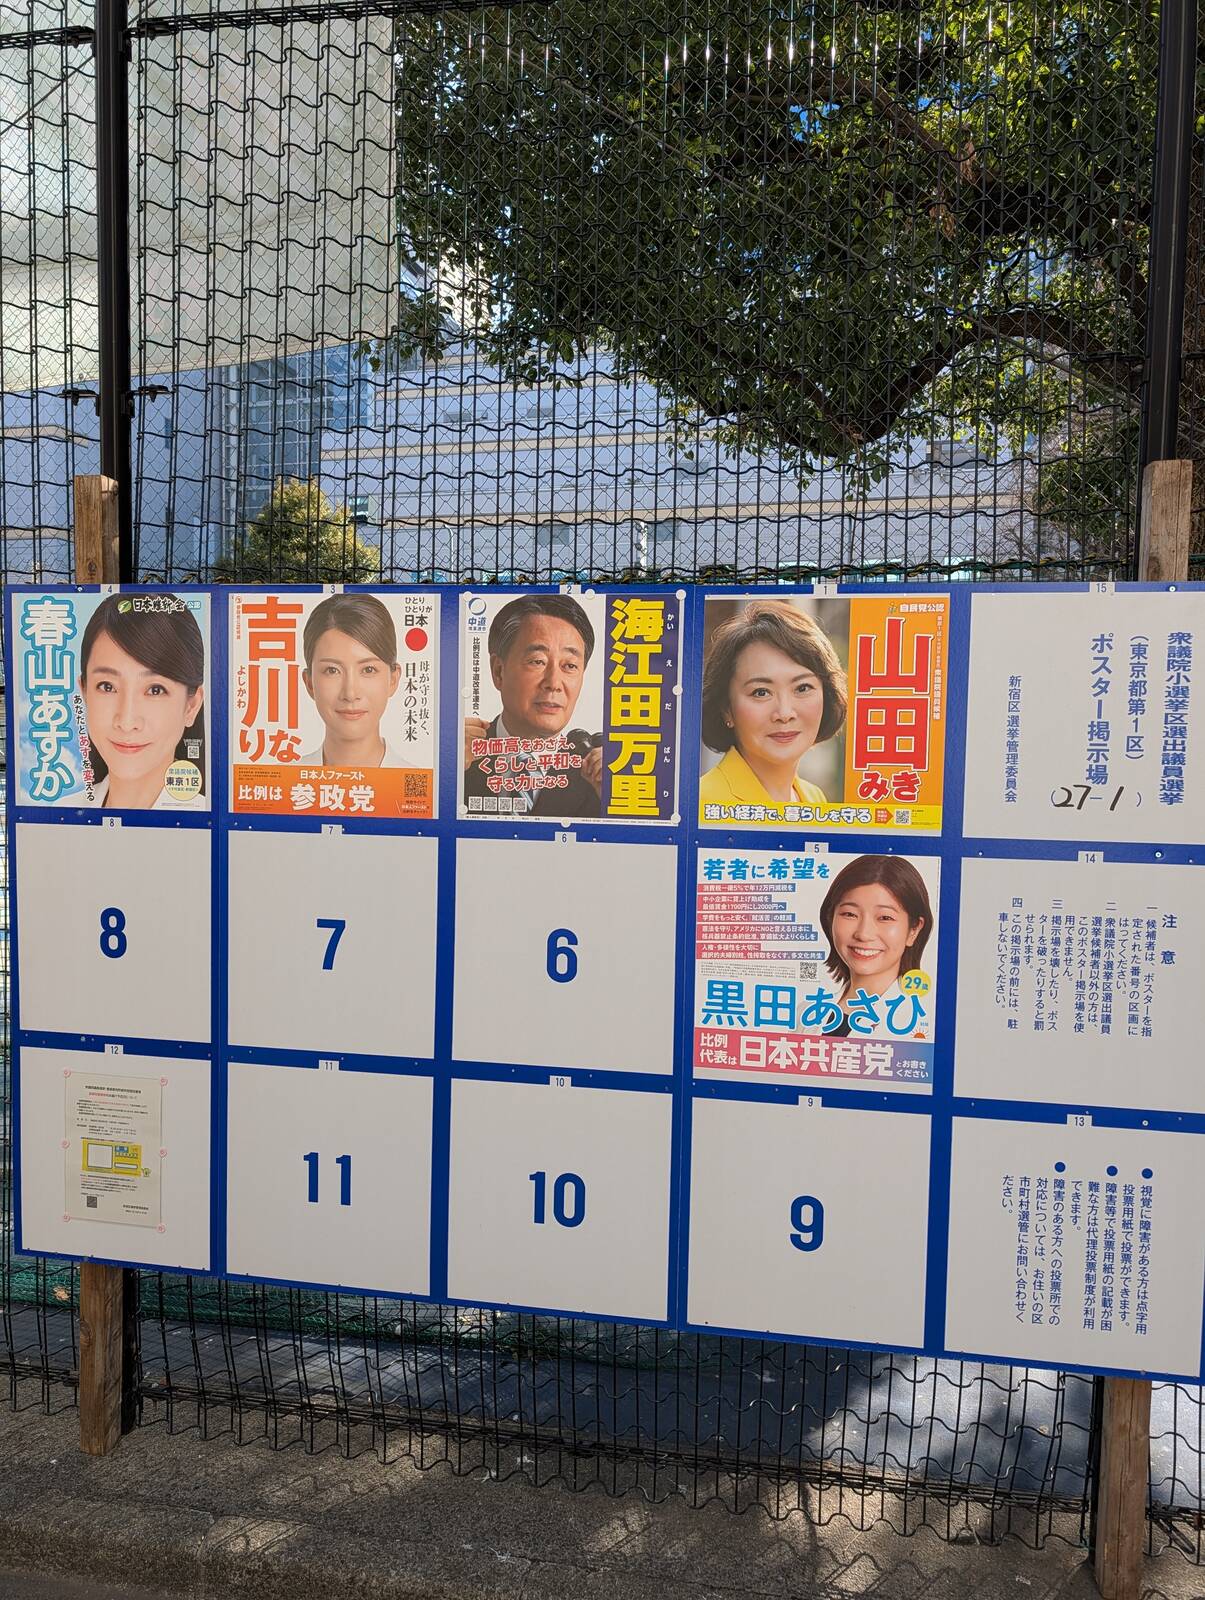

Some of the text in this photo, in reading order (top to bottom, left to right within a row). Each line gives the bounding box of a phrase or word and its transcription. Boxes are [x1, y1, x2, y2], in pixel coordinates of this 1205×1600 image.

[108, 585, 112, 593] 4
[331, 585, 335, 593] 3
[405, 605, 432, 613] ひとりが
[823, 586, 827, 594] 1
[899, 603, 945, 613] 自民党公認
[1097, 583, 1106, 593] 15
[404, 614, 428, 627] 日本
[468, 616, 487, 626] 中道
[667, 613, 673, 630] かい
[236, 666, 246, 709] よしかわ
[241, 595, 303, 730] 吉川
[23, 598, 76, 799] 春山あすか
[404, 663, 418, 742] 日本の未来
[419, 661, 431, 736] 母が守り抜く、
[608, 599, 665, 816] 海江田万里
[854, 617, 933, 771] 山田
[1086, 633, 1114, 785] ポスター掲示場
[1160, 631, 1193, 805] 衆議院小選挙区選出議員選挙
[73, 695, 94, 801] あなたとあすを変える
[239, 729, 302, 763] りな
[472, 737, 576, 756] 物価高をおさえ、
[479, 754, 582, 772] くらしと平和を
[1005, 675, 1021, 803] 新宿区選挙管理委員会
[166, 777, 199, 786] 東京1区
[238, 783, 375, 813] 比例は 参政党
[300, 770, 365, 781] 日本人ファースト
[487, 775, 568, 792] 守る力になる
[858, 771, 921, 803] みき
[109, 818, 114, 827] 8
[329, 826, 333, 834] 7
[561, 833, 567, 843] 6
[704, 804, 872, 822] 強い経済で、暮らしを守る
[703, 857, 830, 880] 若者に希望を
[814, 844, 819, 853] 5
[1085, 854, 1095, 863] 14
[100, 907, 128, 960] 8
[315, 918, 347, 971] 7
[545, 927, 579, 983] 6
[1024, 914, 1035, 969] せられます。
[1063, 915, 1075, 981] 用できません。
[1116, 918, 1129, 995] はってください。
[995, 912, 1008, 1009] 車しないでください。
[1008, 897, 1023, 1030] 四 この掲示場の前には、駐
[1034, 915, 1048, 1031] ターを破ったりすると罰
[1048, 915, 1062, 1031] 掲示場を壊したり、ポス
[1074, 916, 1088, 1033] このポスター掲示場を使
[1087, 916, 1102, 1028] 選挙候補者以外の方は、
[1101, 917, 1116, 1035] 衆議院小選挙区選出議員
[1128, 919, 1143, 1035] 定された番号の区画に
[1141, 919, 1157, 1037] 候補者は、ポスターを指
[701, 980, 926, 1035] 黒田あさひ
[111, 1046, 118, 1054] 12
[700, 1033, 727, 1047] 比例
[700, 1049, 737, 1066] 代表は
[740, 1035, 894, 1076] 日本共産党
[896, 1061, 927, 1069] とお書き
[324, 1061, 333, 1071] 11
[554, 1077, 565, 1087] 10
[896, 1069, 929, 1078] ください
[808, 1098, 813, 1107] 9
[1074, 1117, 1085, 1126] 13
[302, 1151, 353, 1206] 11
[528, 1170, 587, 1228] 10
[1002, 1175, 1014, 1214] ださい。
[790, 1195, 824, 1252] 9
[1071, 1180, 1082, 1231] できます。
[1015, 1176, 1031, 1323] 市町村選管にお問い合わせく
[1032, 1178, 1048, 1324] 対応については、お住いの区
[1049, 1179, 1065, 1326] 障害のある方への投票所での
[1083, 1181, 1100, 1330] 難な方は代理投票制度が利用
[1101, 1183, 1117, 1331] 障害等で投票用紙の記載が困
[1119, 1185, 1135, 1327] 投票用紙で投票ができます。
[1136, 1185, 1152, 1335] 視覚に障害がある方は点字用
